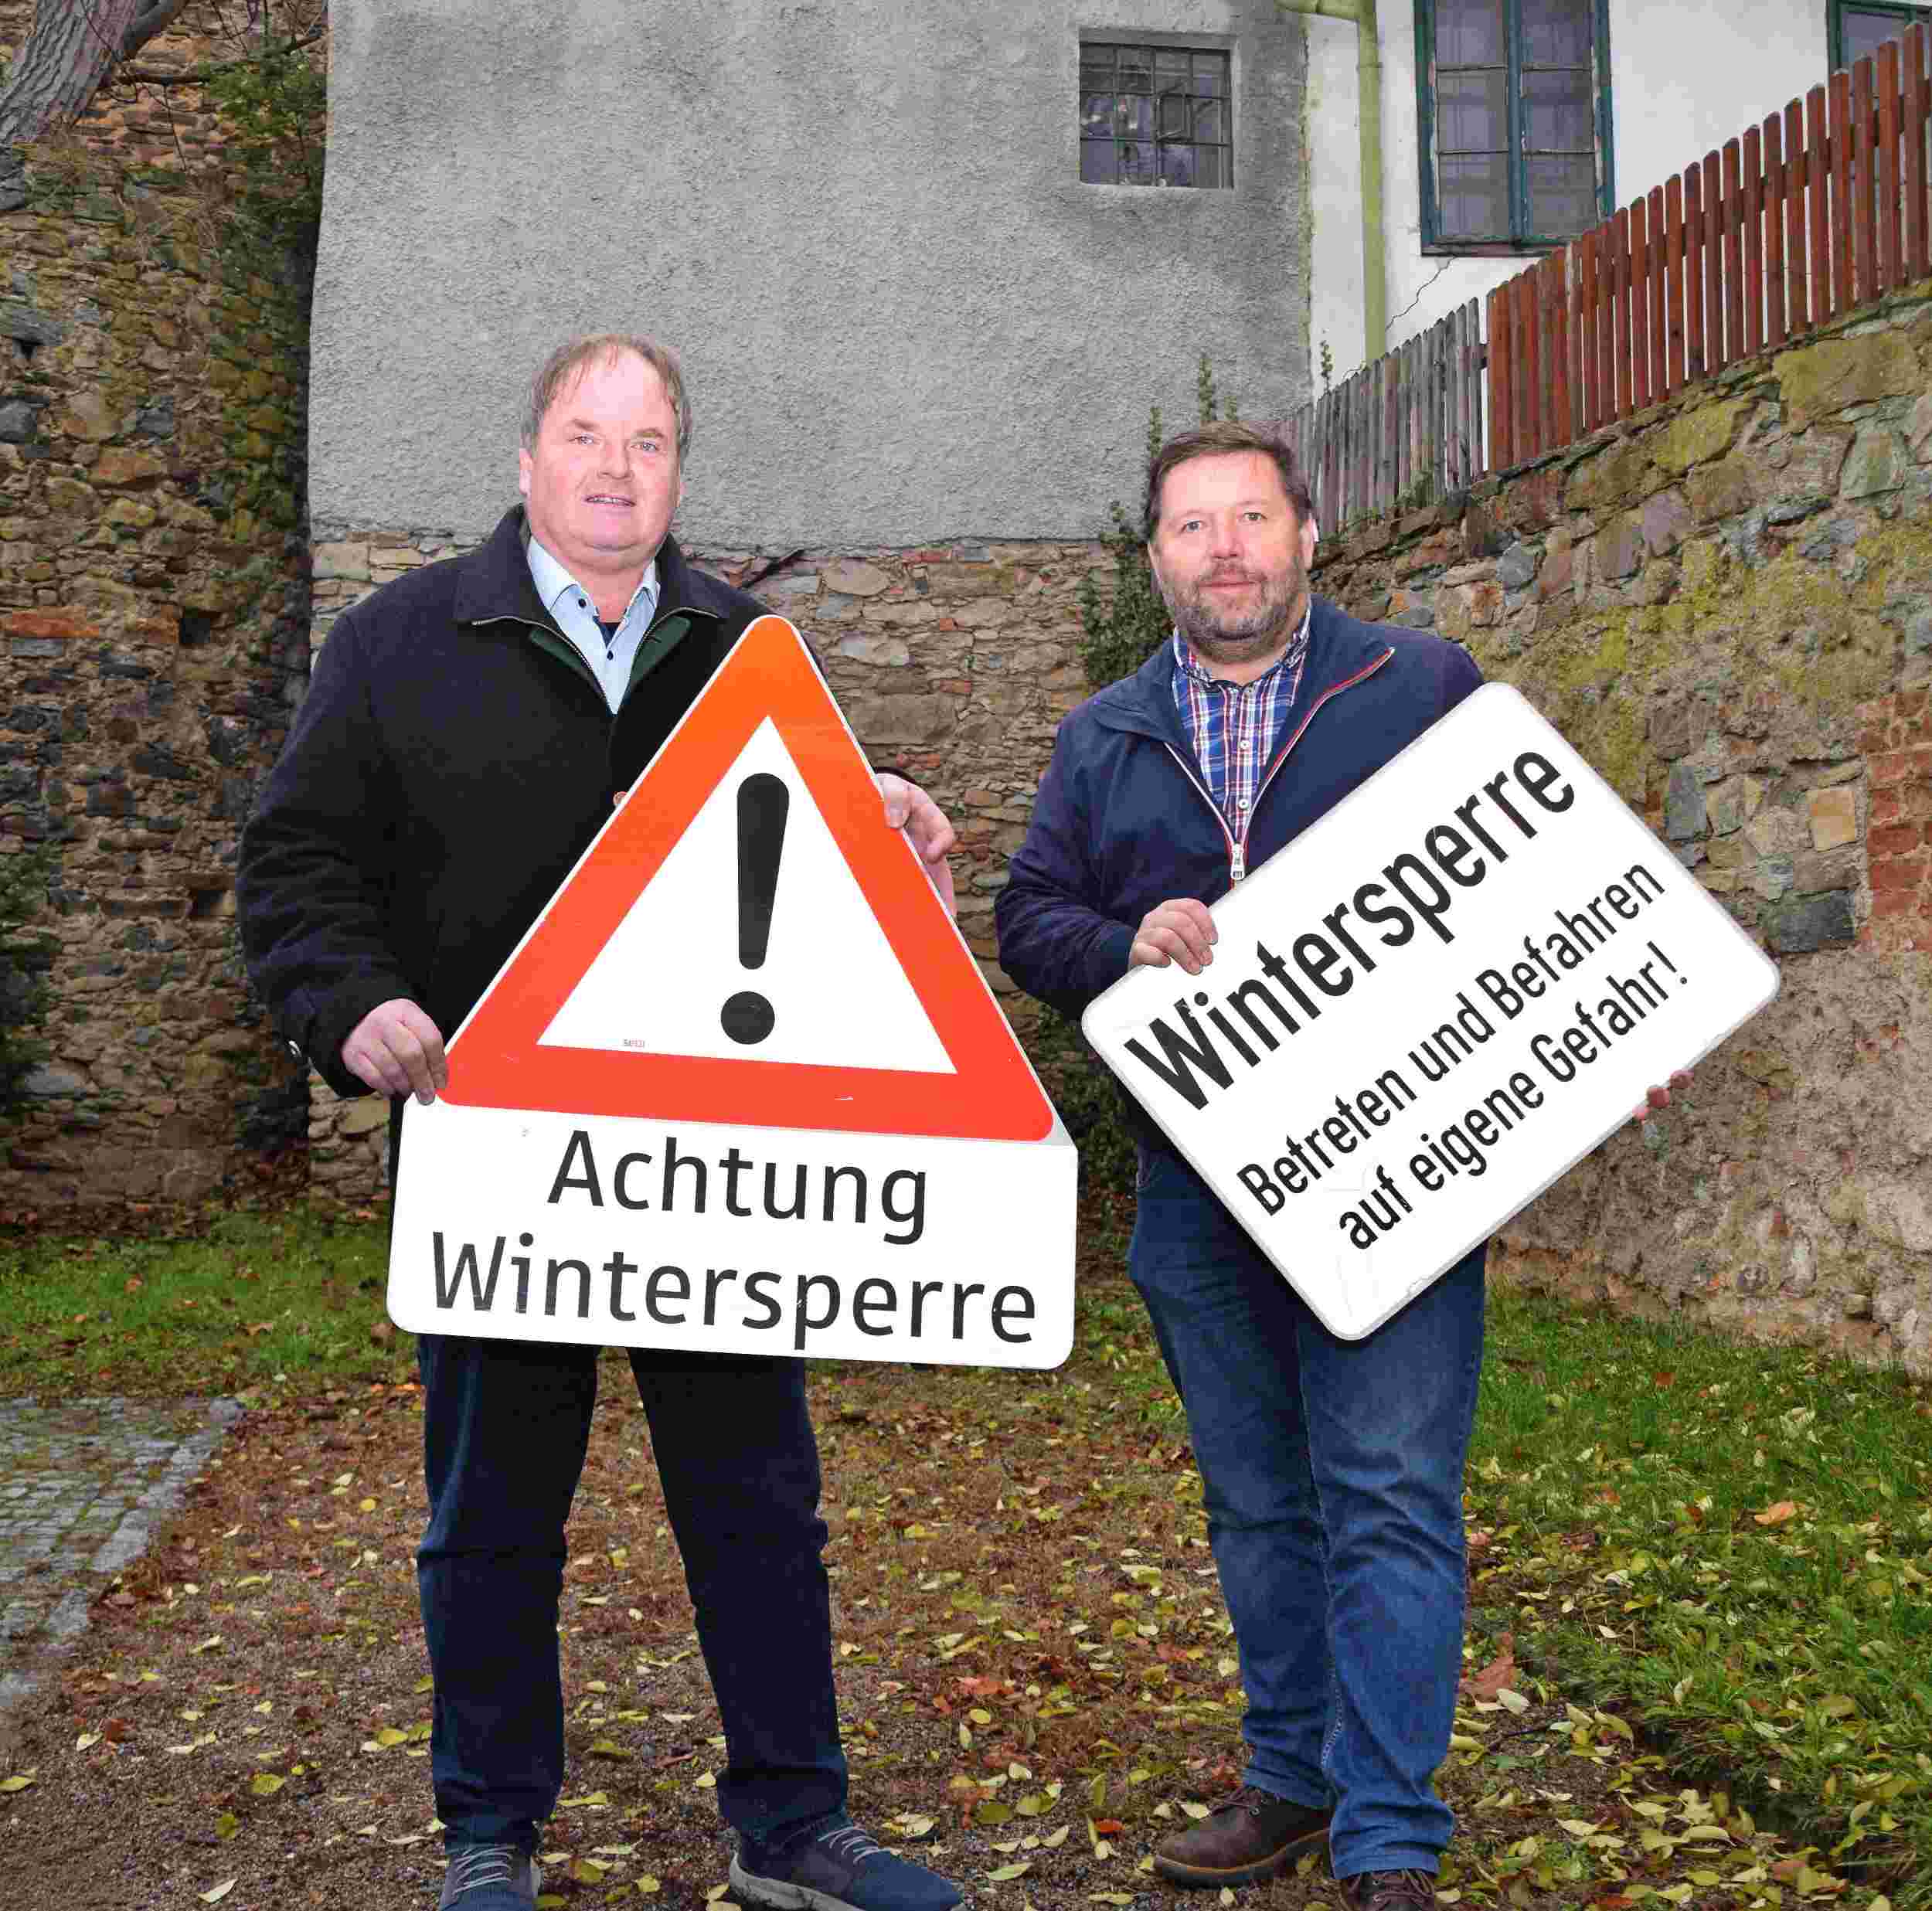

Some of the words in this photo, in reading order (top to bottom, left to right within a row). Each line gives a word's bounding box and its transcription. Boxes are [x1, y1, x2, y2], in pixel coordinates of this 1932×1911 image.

[1124, 752, 1575, 1110] Wintersperre
[1236, 1070, 1417, 1216] Betreten
[1408, 992, 1497, 1082] und
[1475, 864, 1665, 1020] Befahren
[547, 1130, 926, 1245] Achtung
[1338, 1165, 1413, 1250] auf
[1409, 1072, 1544, 1192] eigene
[1530, 940, 1688, 1083] Gefahr!
[432, 1231, 1035, 1351] Wintersperre
